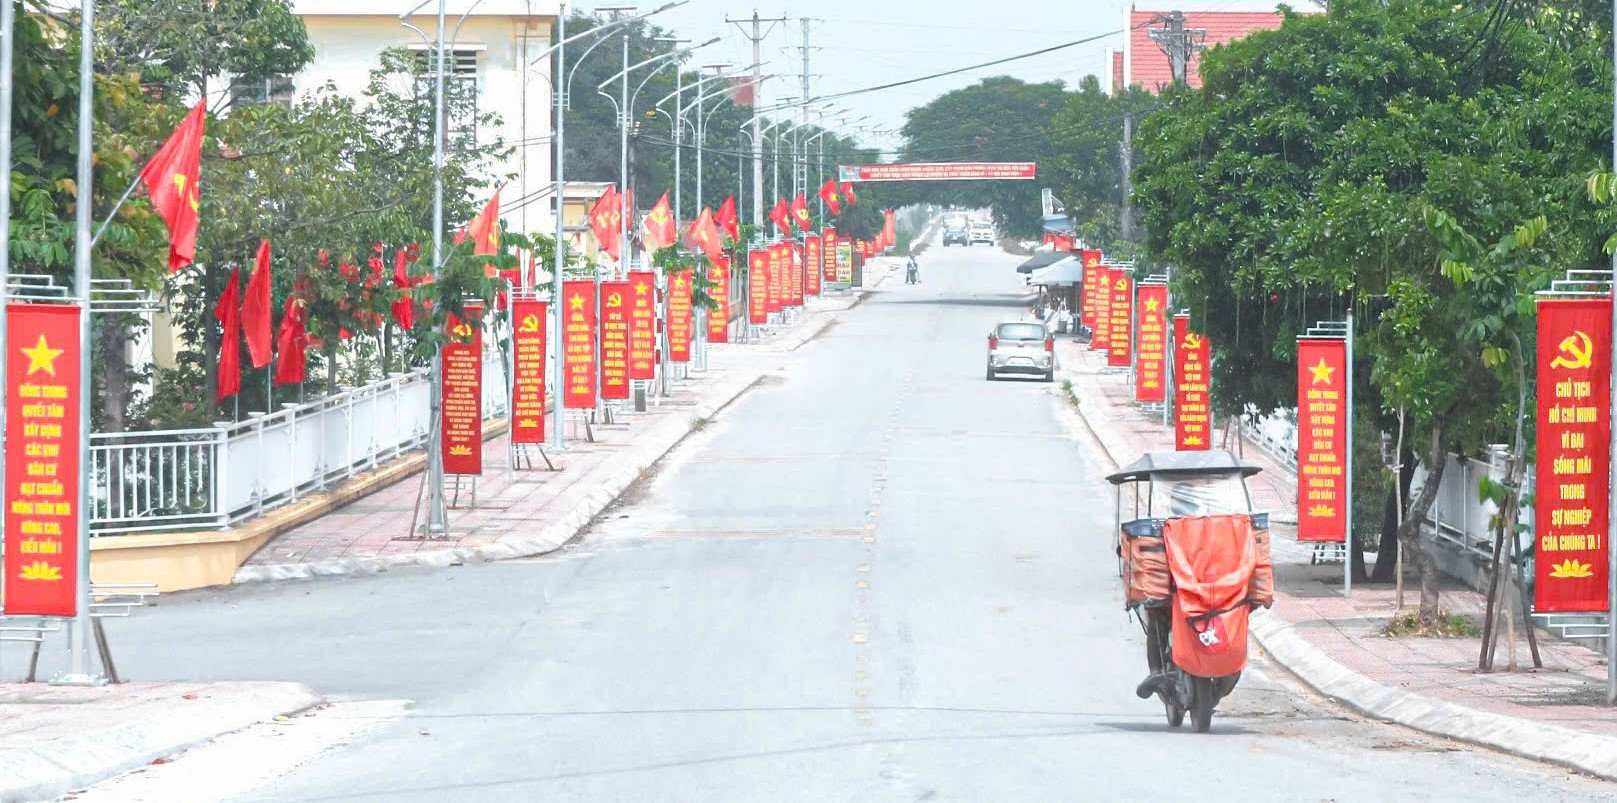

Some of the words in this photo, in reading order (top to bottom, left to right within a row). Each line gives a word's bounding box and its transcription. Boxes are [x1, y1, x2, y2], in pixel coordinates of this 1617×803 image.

[1556, 377, 1571, 397] CHỦ
[1574, 382, 1591, 400] TỊCH
[1576, 407, 1597, 423] MINH
[1561, 430, 1569, 448] VĨ
[1570, 433, 1584, 452] ĐẠI
[1553, 454, 1575, 474] SỐNG
[1576, 455, 1592, 474] MÃI
[1560, 484, 1585, 500] TRONG
[1552, 509, 1563, 528] SỰ
[1564, 506, 1592, 528] NGHIỆP
[1542, 530, 1558, 551] CỦA
[1559, 532, 1585, 551] CHÚNG
[1587, 534, 1596, 550] TA
